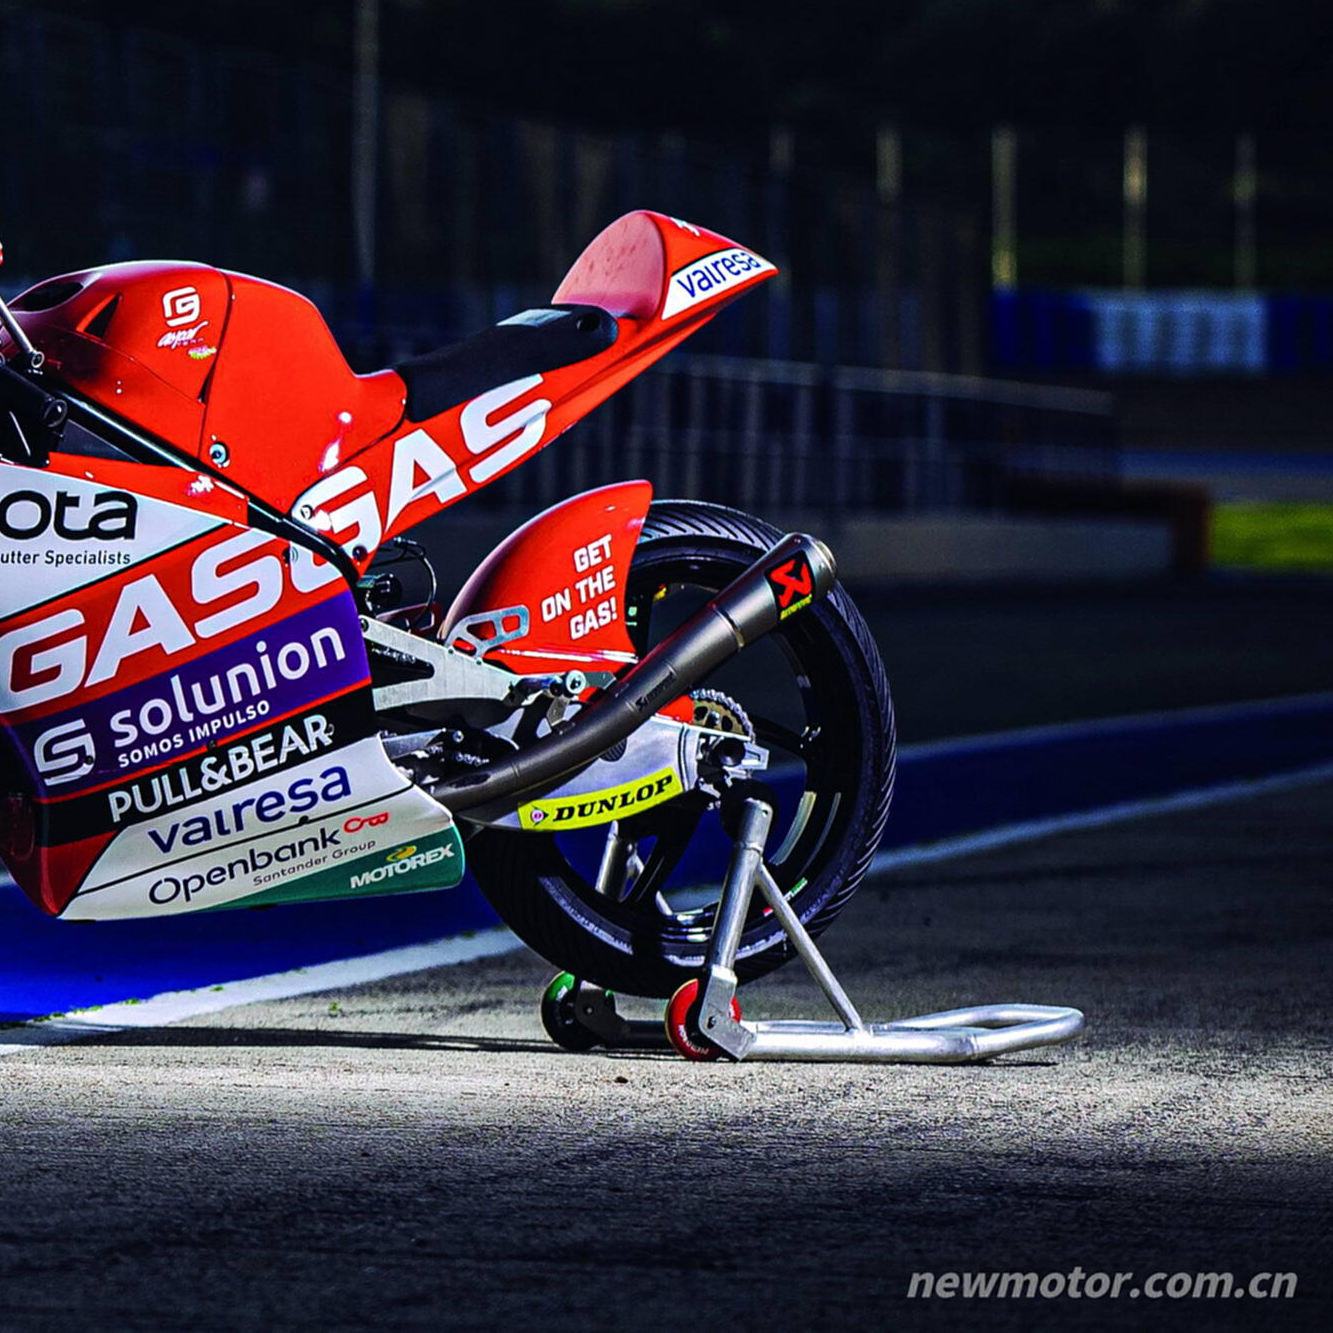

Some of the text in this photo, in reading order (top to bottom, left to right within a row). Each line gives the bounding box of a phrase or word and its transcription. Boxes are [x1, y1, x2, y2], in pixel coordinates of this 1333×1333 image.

[676, 252, 761, 298] valresa
[45, 549, 131, 567] Specialists
[573, 533, 612, 573] GET
[541, 565, 616, 623] ON THE
[570, 596, 617, 640] GAS!
[110, 626, 346, 747] solunion
[118, 700, 270, 768] SOMOS IMPULSO
[108, 714, 333, 822] PULL&BEAR
[148, 765, 352, 854] valresa
[552, 774, 674, 823] DUNLOP
[149, 827, 342, 904] Openbank
[253, 840, 376, 887] Santander Group
[350, 843, 455, 889] MOTOREX
